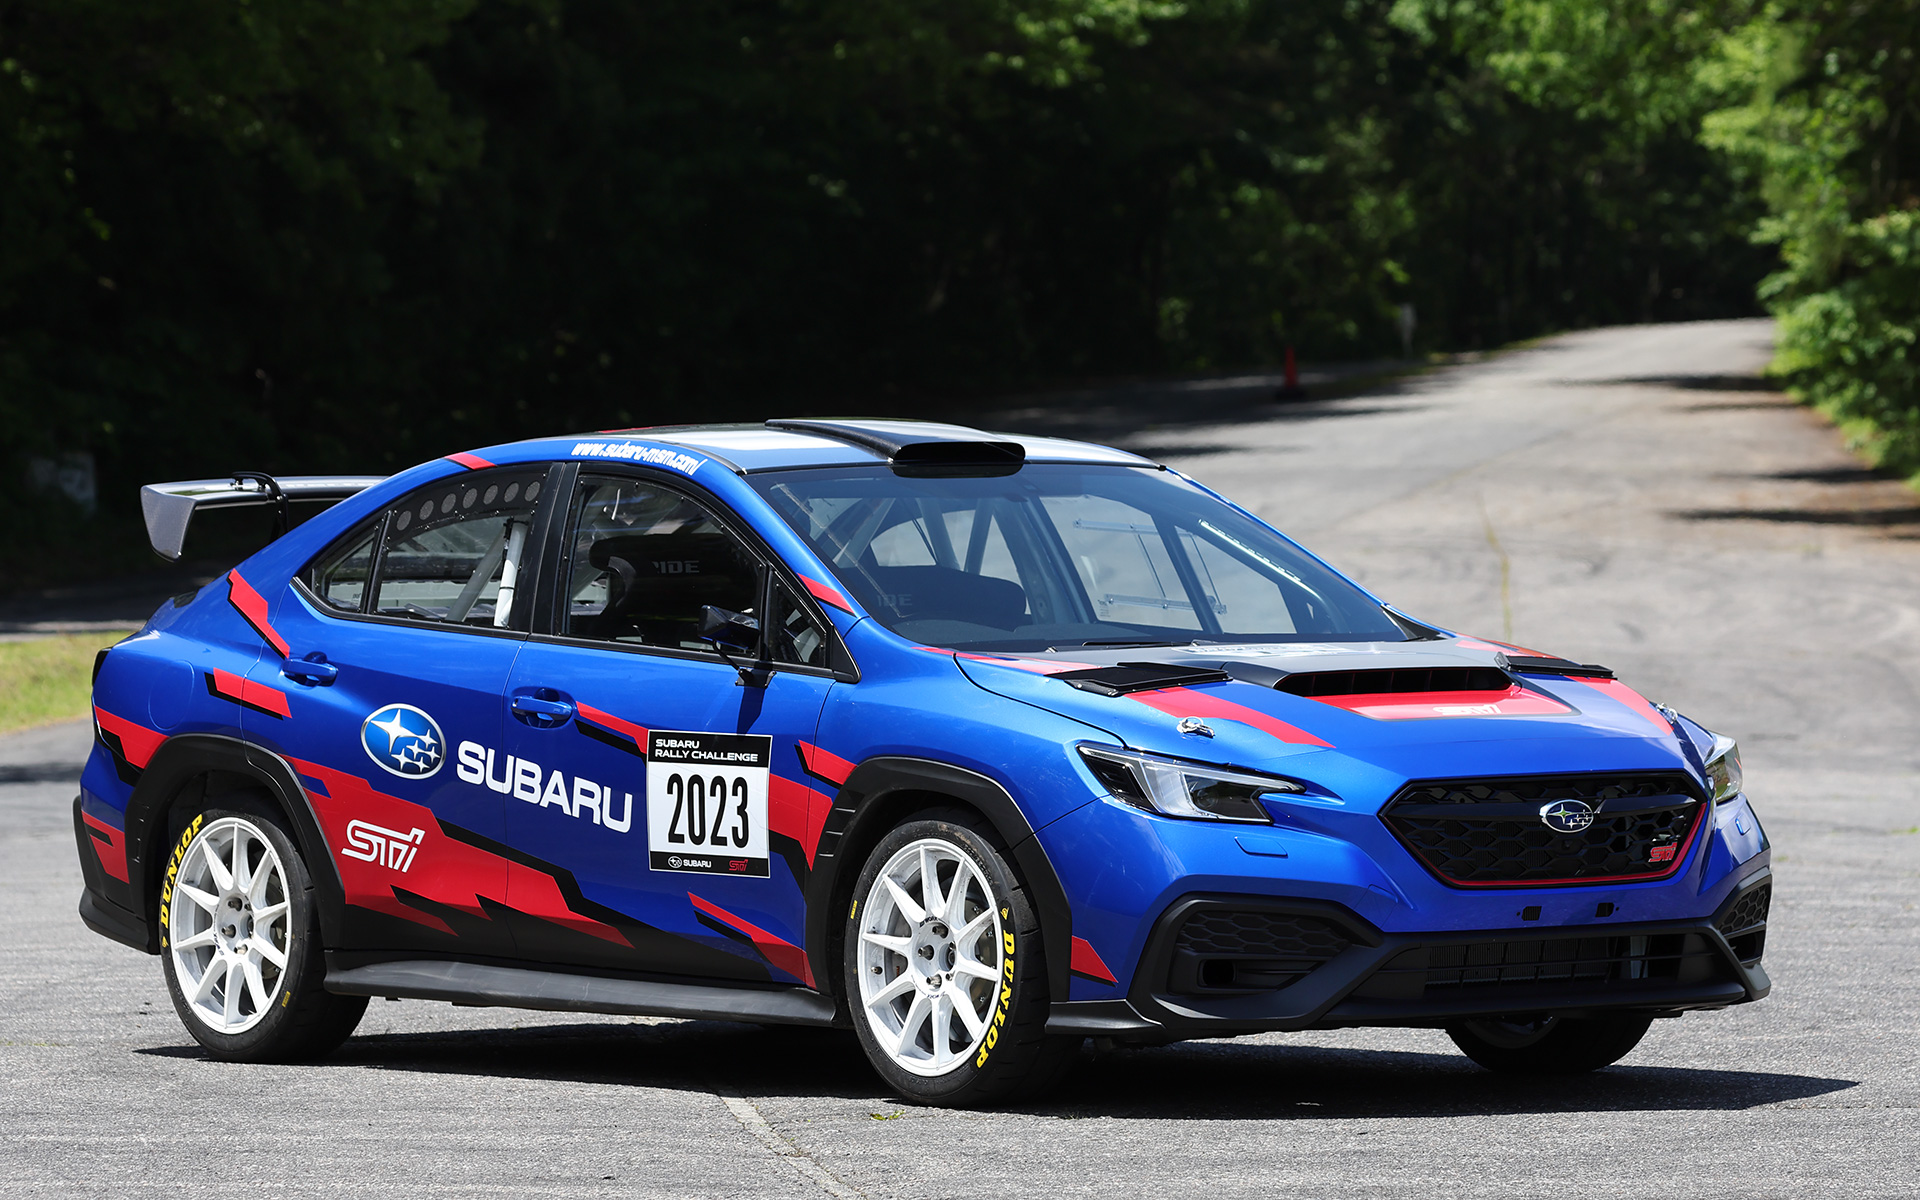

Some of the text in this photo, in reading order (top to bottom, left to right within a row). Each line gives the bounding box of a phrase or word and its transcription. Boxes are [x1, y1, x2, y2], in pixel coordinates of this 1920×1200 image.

[652, 560, 700, 574] IDE
[655, 739, 700, 749] SUBARU
[655, 749, 759, 762] RALLY CHALLENGE
[457, 740, 633, 833] SUBARU
[667, 773, 749, 848] 2023
[160, 814, 203, 929] DUNLOP
[683, 859, 712, 869] SUBARU
[976, 929, 1015, 1069] DUNLOP
